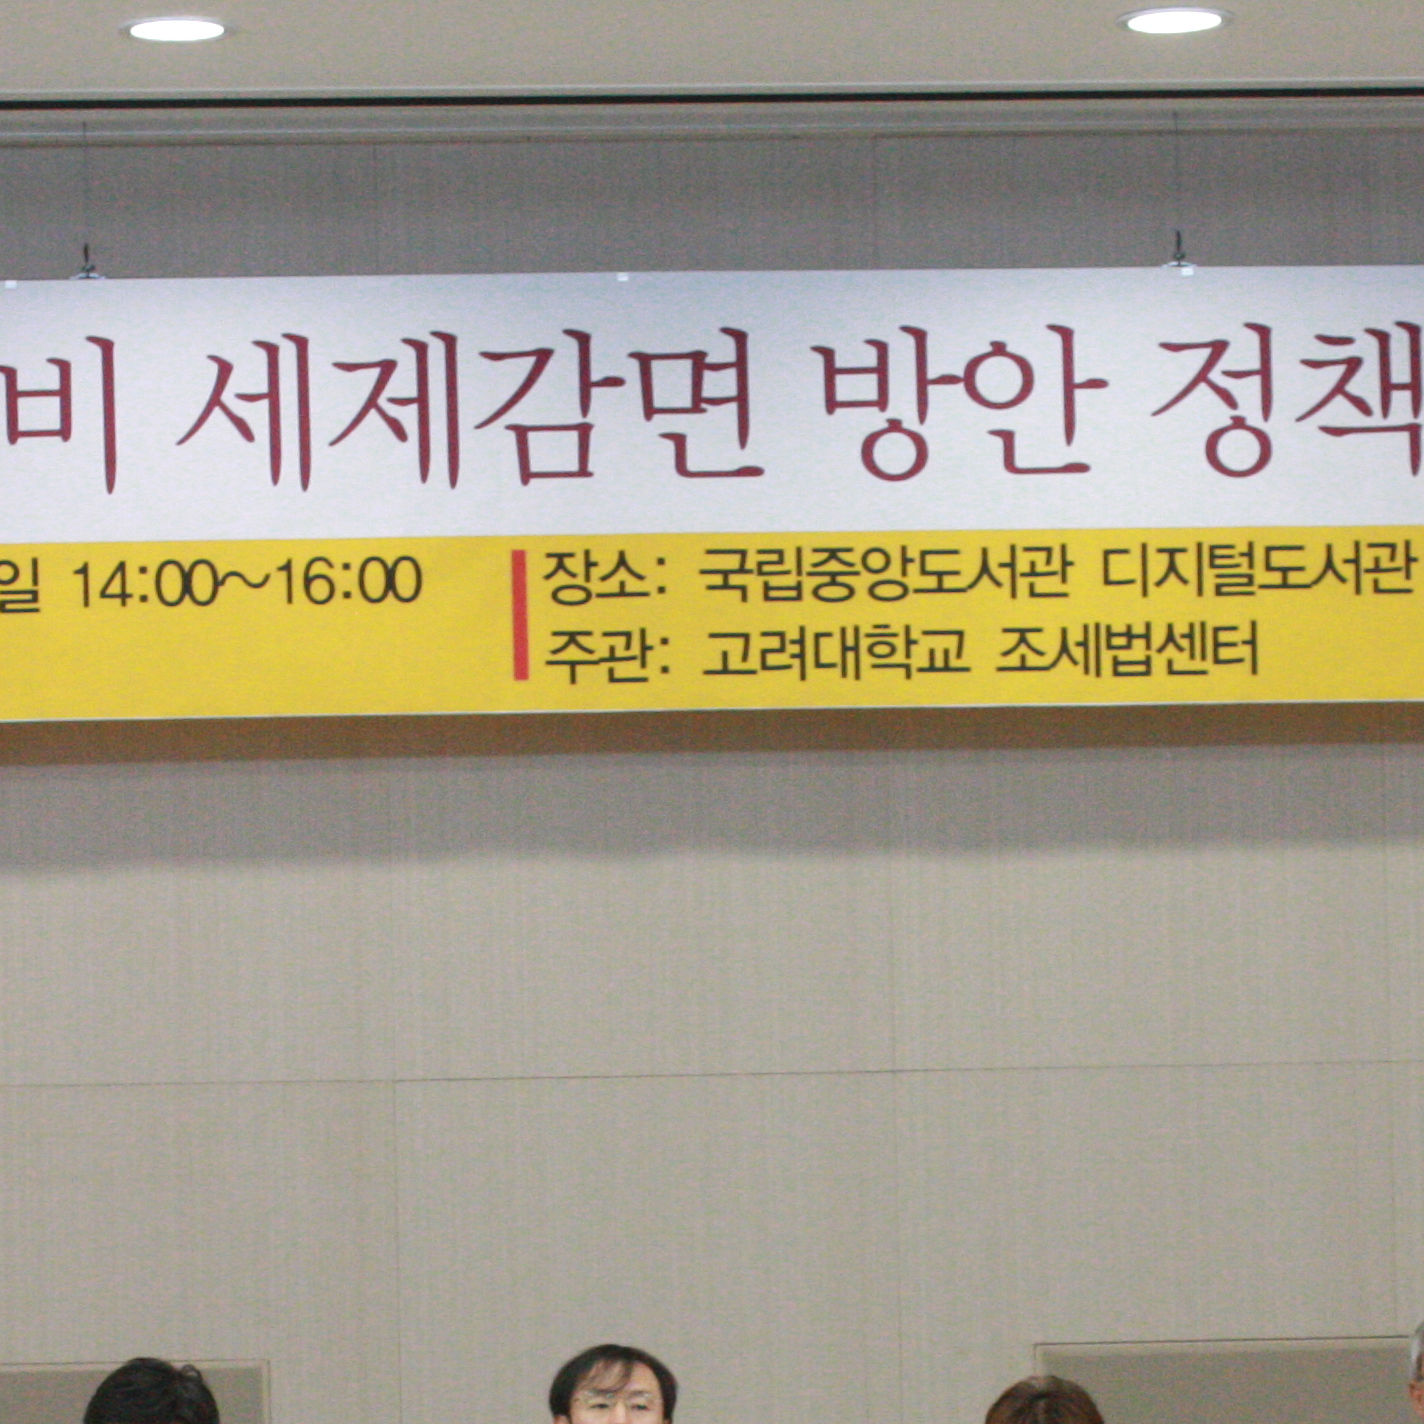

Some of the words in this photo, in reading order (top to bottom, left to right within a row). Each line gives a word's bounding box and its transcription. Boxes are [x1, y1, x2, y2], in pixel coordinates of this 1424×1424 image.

[178, 326, 767, 493] 세제감면
[810, 324, 1110, 484] 방안
[73, 555, 425, 609] 14:00~16:00
[543, 548, 668, 609] 장소:
[699, 543, 1076, 605] 국립중앙도서관
[1103, 539, 1421, 599] 디지털도서관
[545, 627, 672, 687] 주관:
[703, 624, 973, 683] 고려대학교
[996, 620, 1260, 680] 조세법센터
